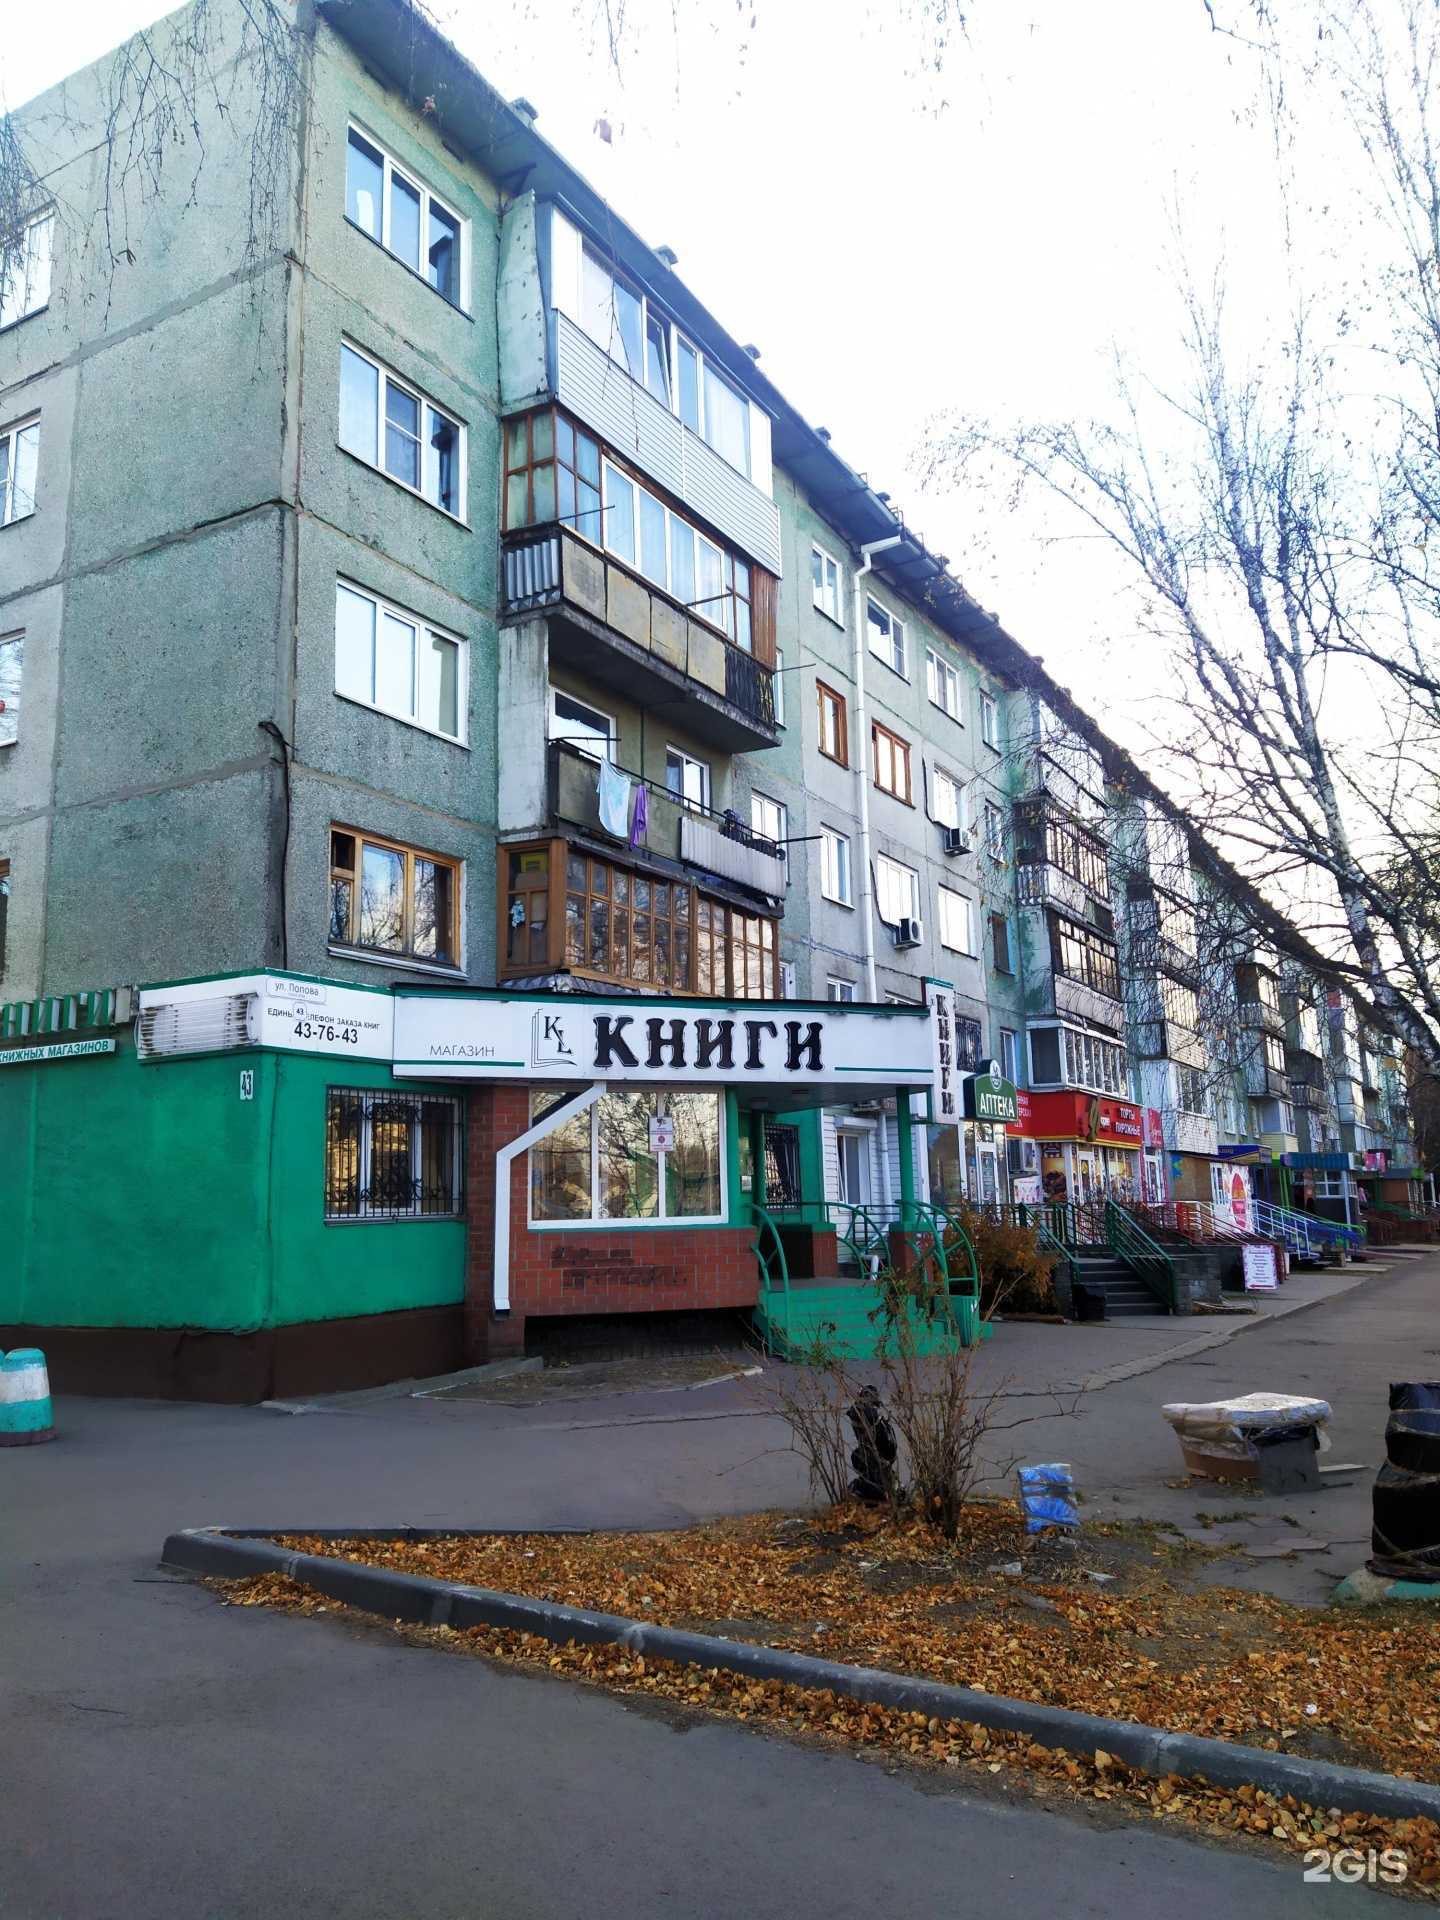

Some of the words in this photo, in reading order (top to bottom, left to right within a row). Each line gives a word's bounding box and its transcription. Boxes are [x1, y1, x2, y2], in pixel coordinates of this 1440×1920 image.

[275, 983, 287, 992] ул.
[289, 983, 319, 996] Попова
[337, 1018, 362, 1028] ЗАКАЗА
[363, 1021, 381, 1030] КНИГ
[294, 1022, 359, 1044] 43-76-43
[47, 1041, 108, 1057] МАГАЗИНОВ
[592, 1014, 825, 1070] КНИГИ
[429, 1044, 495, 1058] МАГАЗИН
[936, 994, 954, 1114] КНИГИ
[241, 1074, 252, 1096] 43
[980, 1092, 1015, 1118] АПТЕКА
[1120, 1107, 1136, 1120] ТОРТЫ
[1115, 1121, 1141, 1136] ПИРОЖНЫЕ
